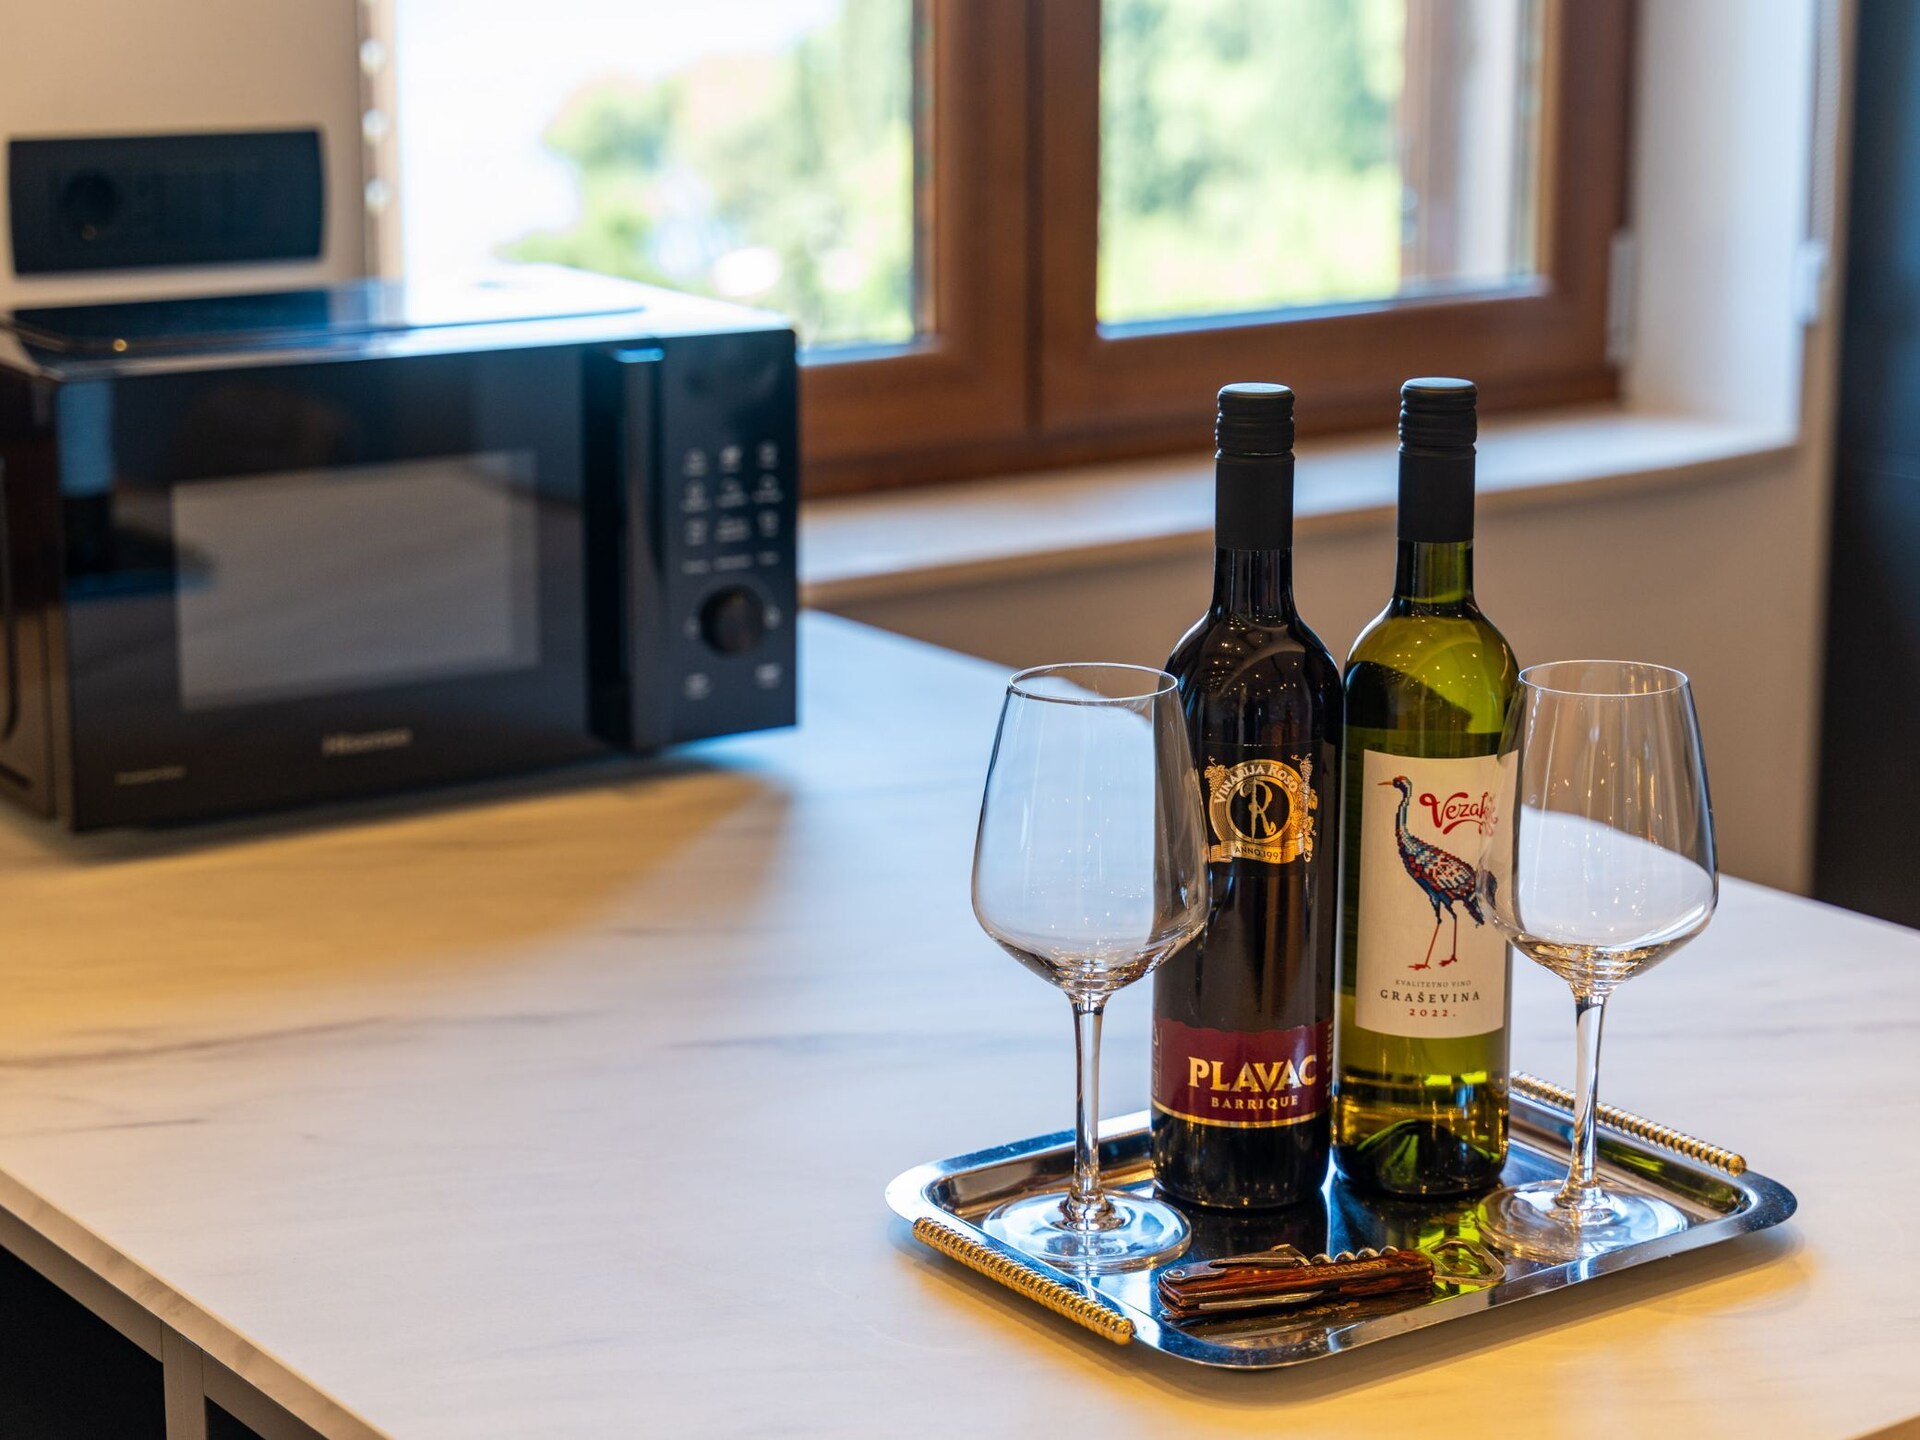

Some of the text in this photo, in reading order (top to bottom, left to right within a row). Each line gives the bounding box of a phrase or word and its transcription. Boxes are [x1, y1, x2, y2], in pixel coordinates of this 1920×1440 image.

[1214, 763, 1298, 803] VINARIJA ROSO
[1235, 846, 1261, 857] ANNO
[1395, 979, 1472, 989] KVALITETNO VINO
[1380, 989, 1480, 1004] GRAŠEVINA
[1409, 1008, 1456, 1018] 2022.
[1188, 1054, 1318, 1094] PLAVAC
[1211, 1095, 1299, 1111] BARRIQUE
